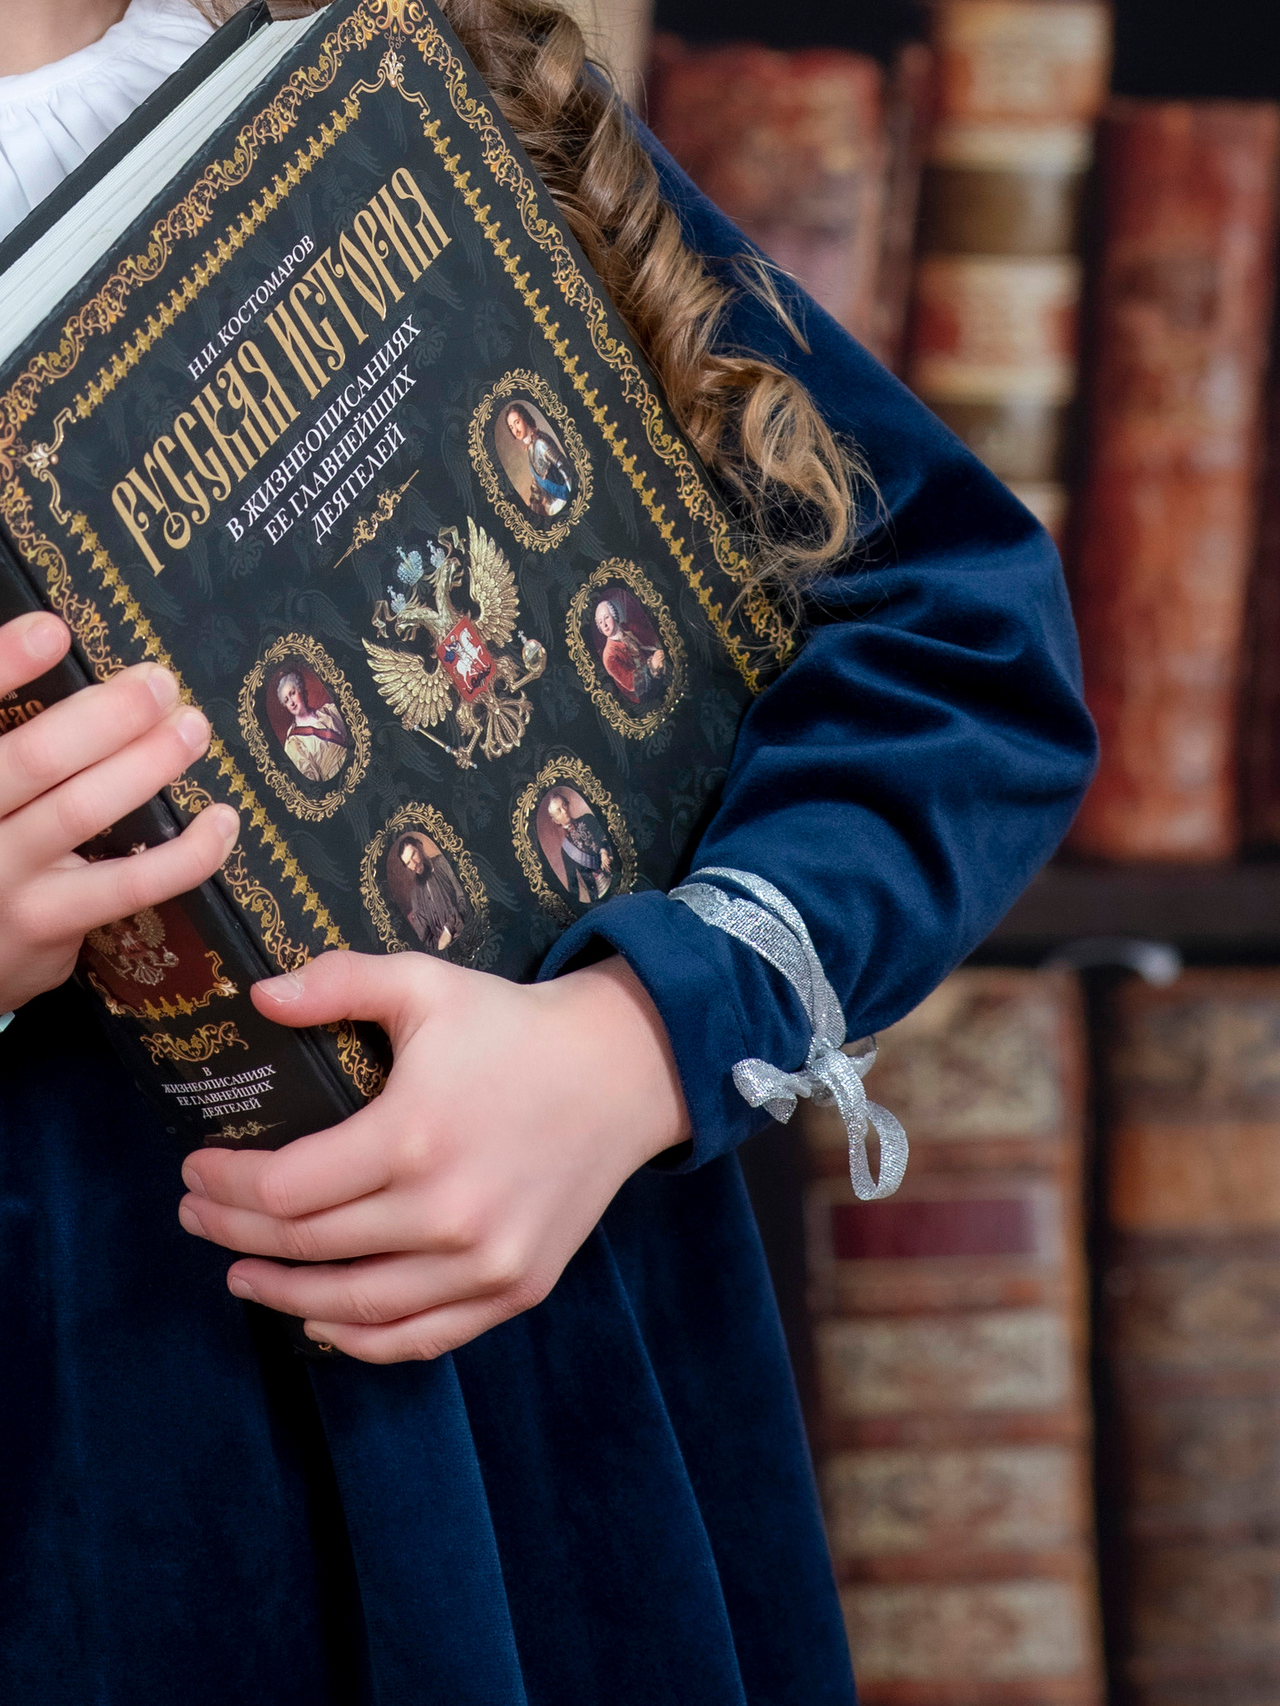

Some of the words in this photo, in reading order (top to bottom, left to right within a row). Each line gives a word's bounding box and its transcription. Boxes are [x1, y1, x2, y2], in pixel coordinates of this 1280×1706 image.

[187, 341, 222, 381] Н.И.
[217, 235, 315, 347] КОСТОМАРОВ
[111, 340, 301, 577] РУССКАЯ
[264, 167, 452, 400] ИСТОРИЯ
[225, 516, 245, 543] В
[240, 314, 421, 527] ЖИЗНЕОПИСАНИЯХ
[263, 507, 294, 545] ЕЕ
[288, 364, 417, 517] ГЛАВНЕЙШИХ
[311, 422, 407, 545] ДЕЯТЕЛЕЙ
[161, 1064, 277, 1094] ЖИЗНЕОПИСАНИЯХ
[176, 1096, 193, 1106] ЕЕ
[191, 1080, 274, 1105] ГЛАВНЕЙШИХ
[201, 1097, 262, 1120] ДЕЯТЕЛЕЙ
[202, 1066, 212, 1077] В
